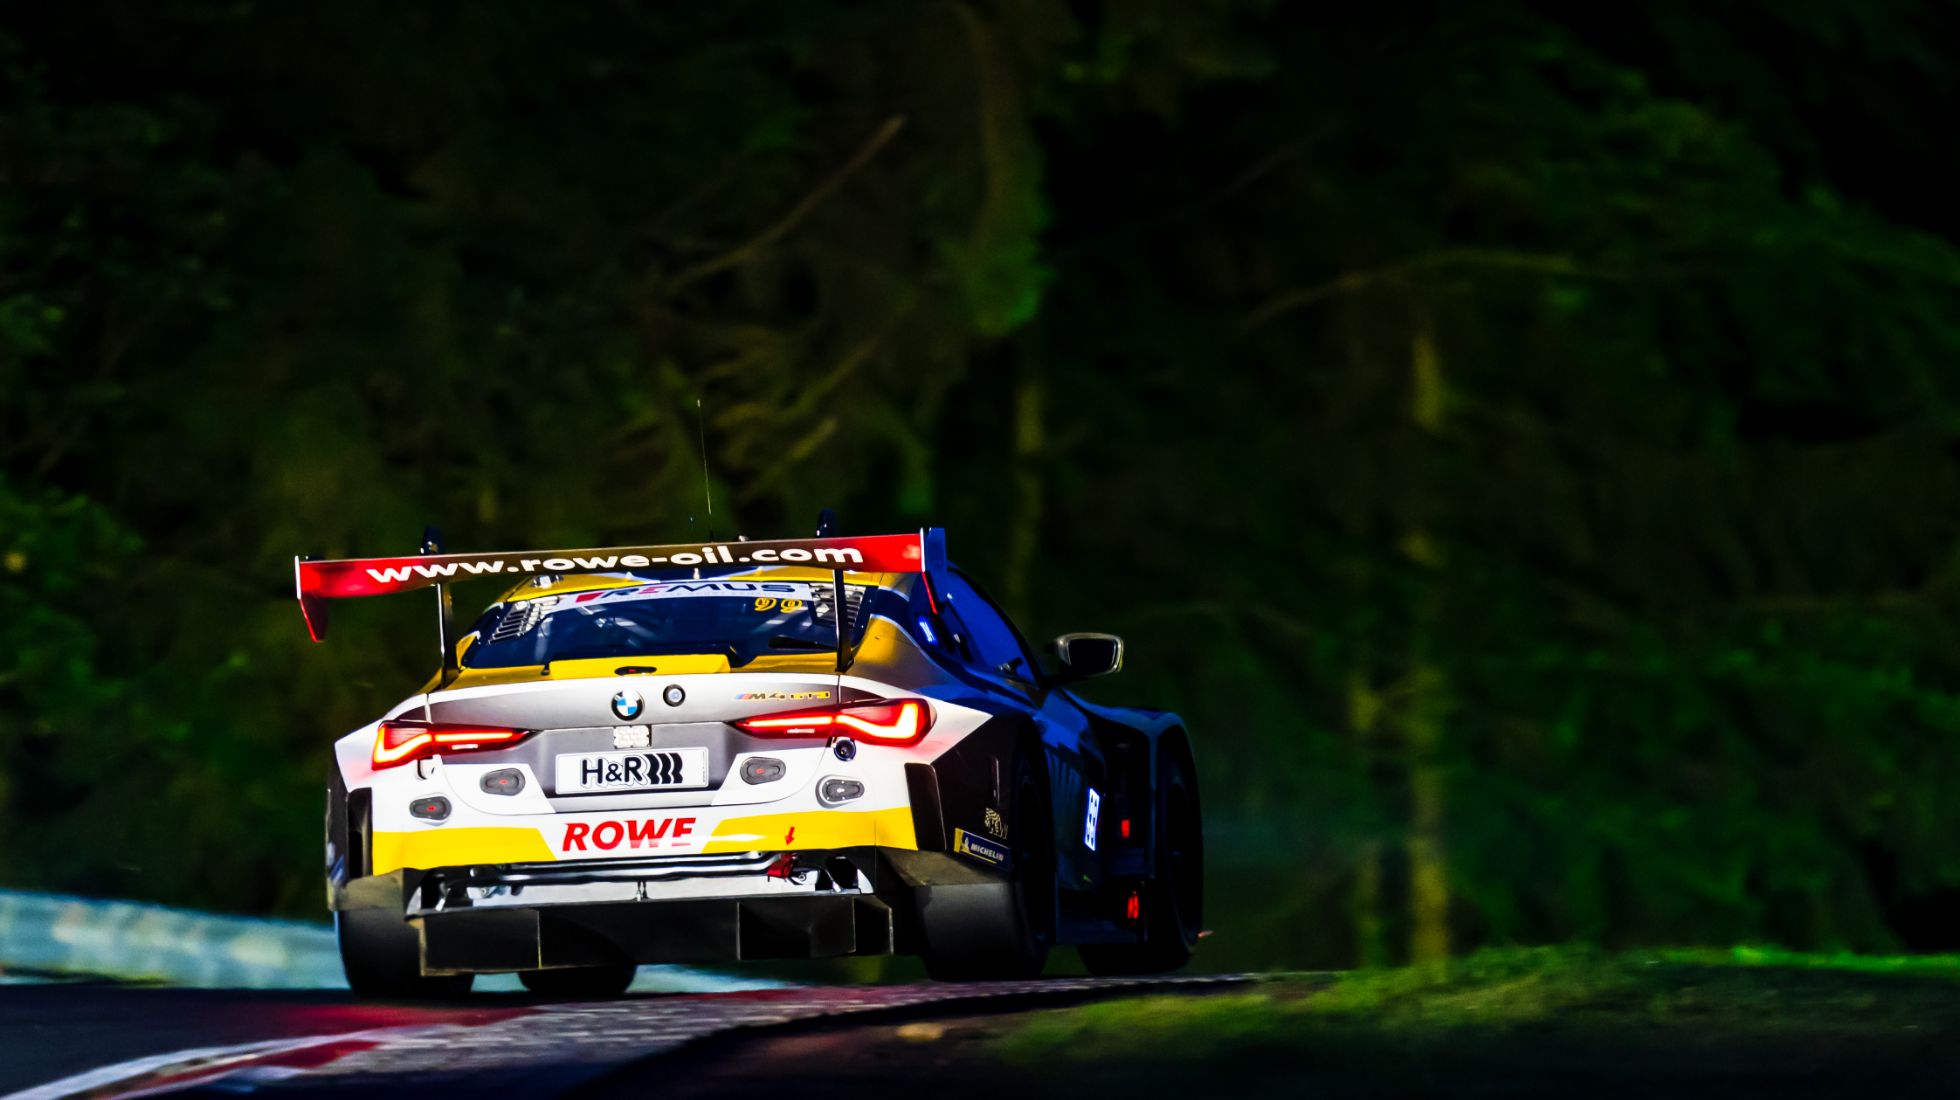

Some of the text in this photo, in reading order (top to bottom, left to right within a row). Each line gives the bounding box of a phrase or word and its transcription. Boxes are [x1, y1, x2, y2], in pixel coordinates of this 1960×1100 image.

[366, 545, 864, 583] www.rowe-oil.com
[600, 582, 796, 600] REMUS
[754, 597, 803, 613] 99
[581, 756, 643, 786] H&R
[562, 817, 697, 852] ROWE
[970, 843, 1005, 862] MICHELIN
